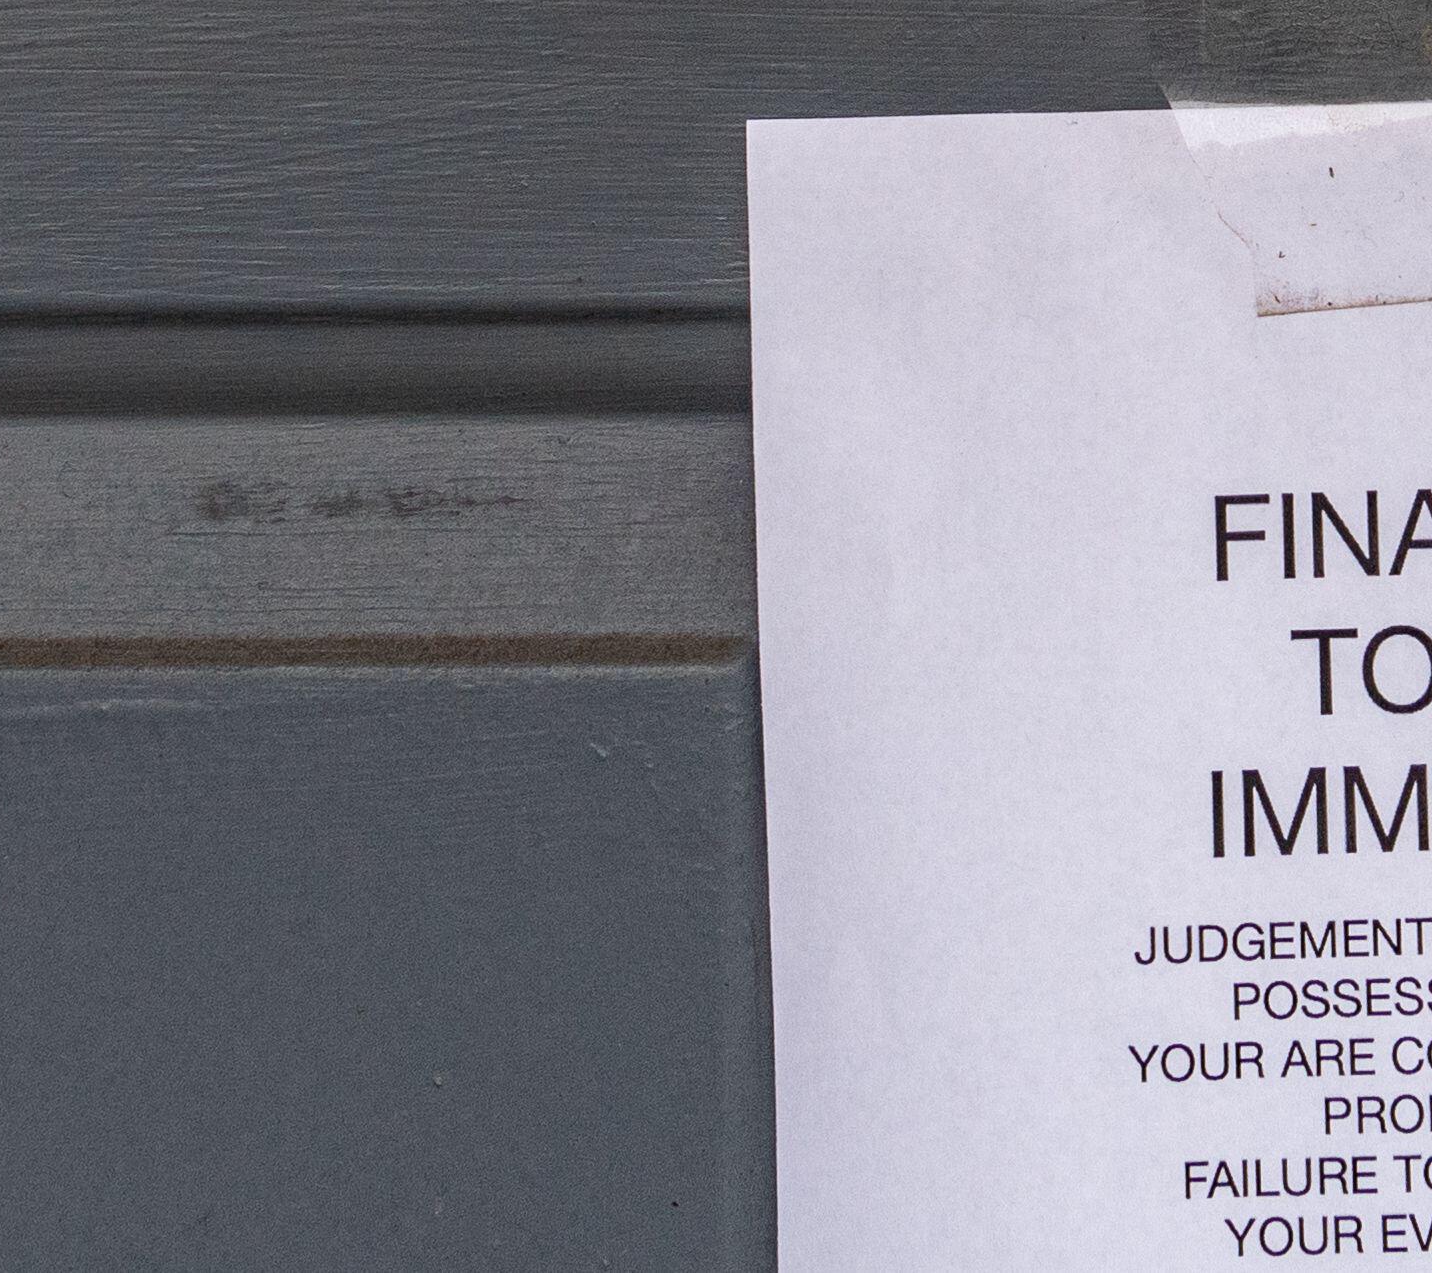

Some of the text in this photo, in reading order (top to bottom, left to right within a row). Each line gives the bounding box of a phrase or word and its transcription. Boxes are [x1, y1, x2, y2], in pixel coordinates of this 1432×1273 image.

[1127, 1041, 1265, 1083] YOUR
[1280, 1037, 1376, 1078] ARE
[1184, 1155, 1379, 1200] FAILURE
[1224, 1215, 1364, 1257] YOUR
